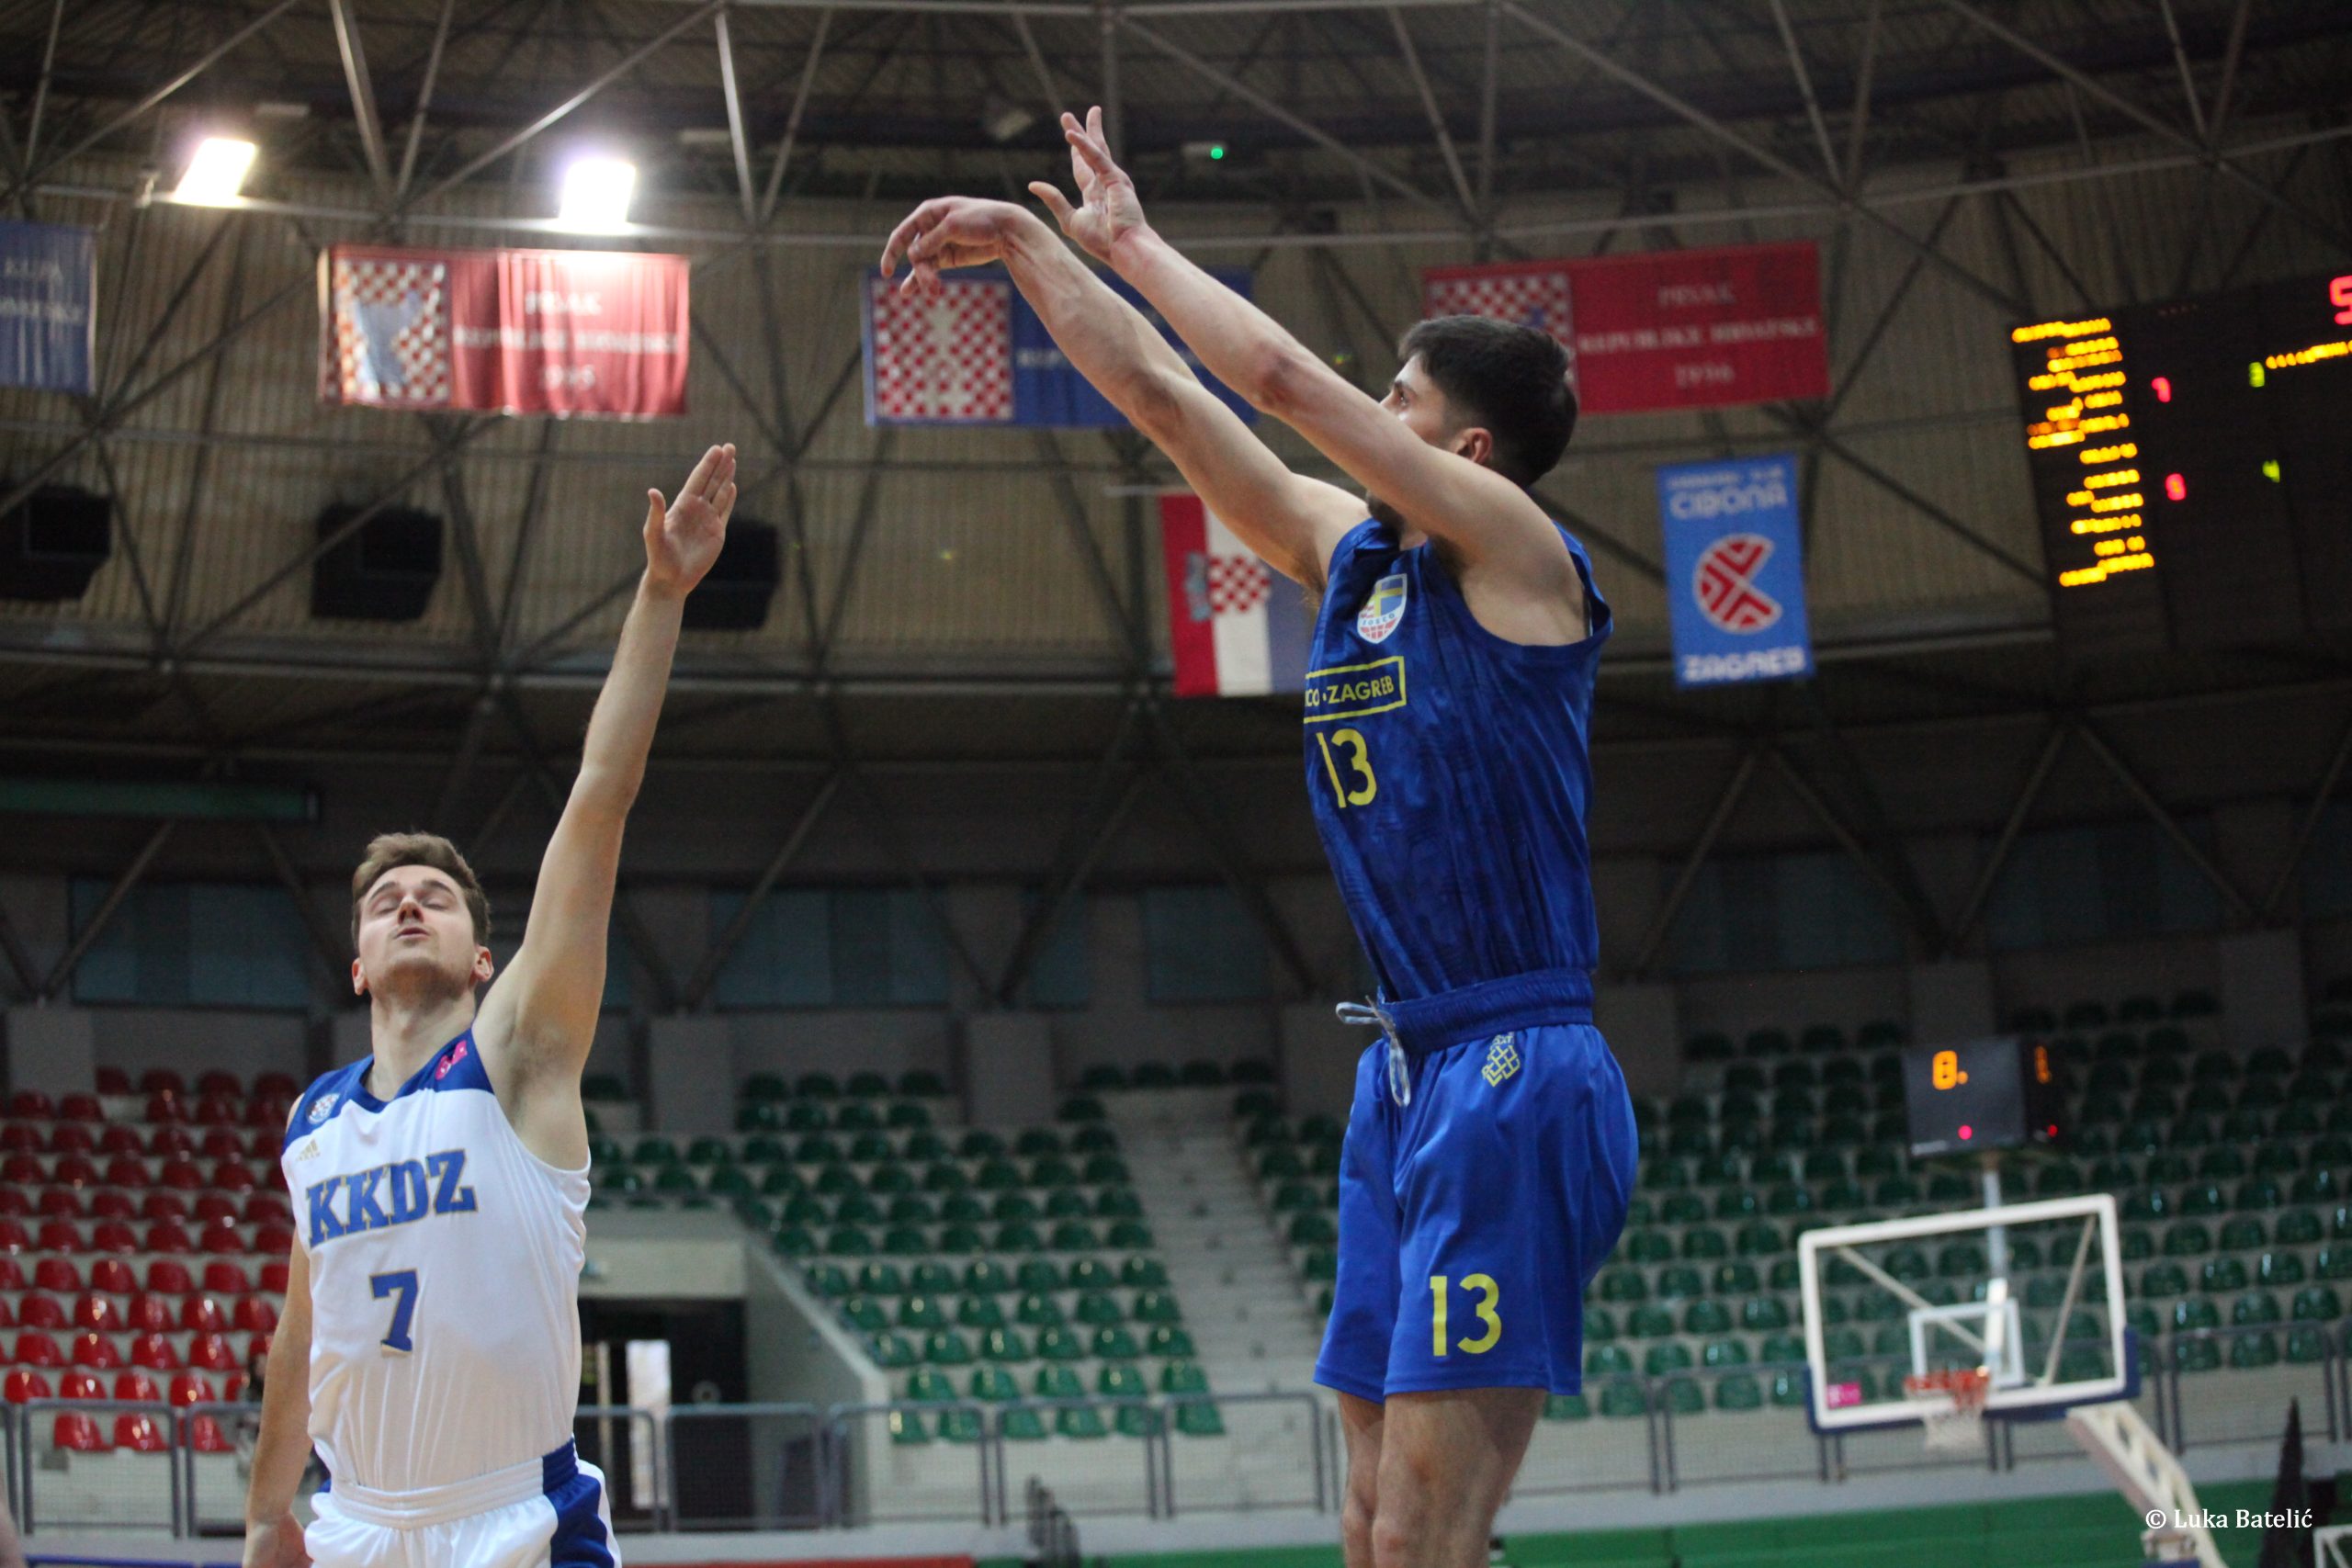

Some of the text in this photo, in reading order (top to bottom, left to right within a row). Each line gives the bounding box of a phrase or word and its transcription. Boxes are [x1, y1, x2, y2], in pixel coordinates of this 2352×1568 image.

[1326, 675, 1394, 705] ZAGREB
[1316, 728, 1376, 808] 13
[306, 1148, 479, 1249] KKDZ
[369, 1268, 419, 1357] 7
[1430, 1273, 1502, 1357] 13
